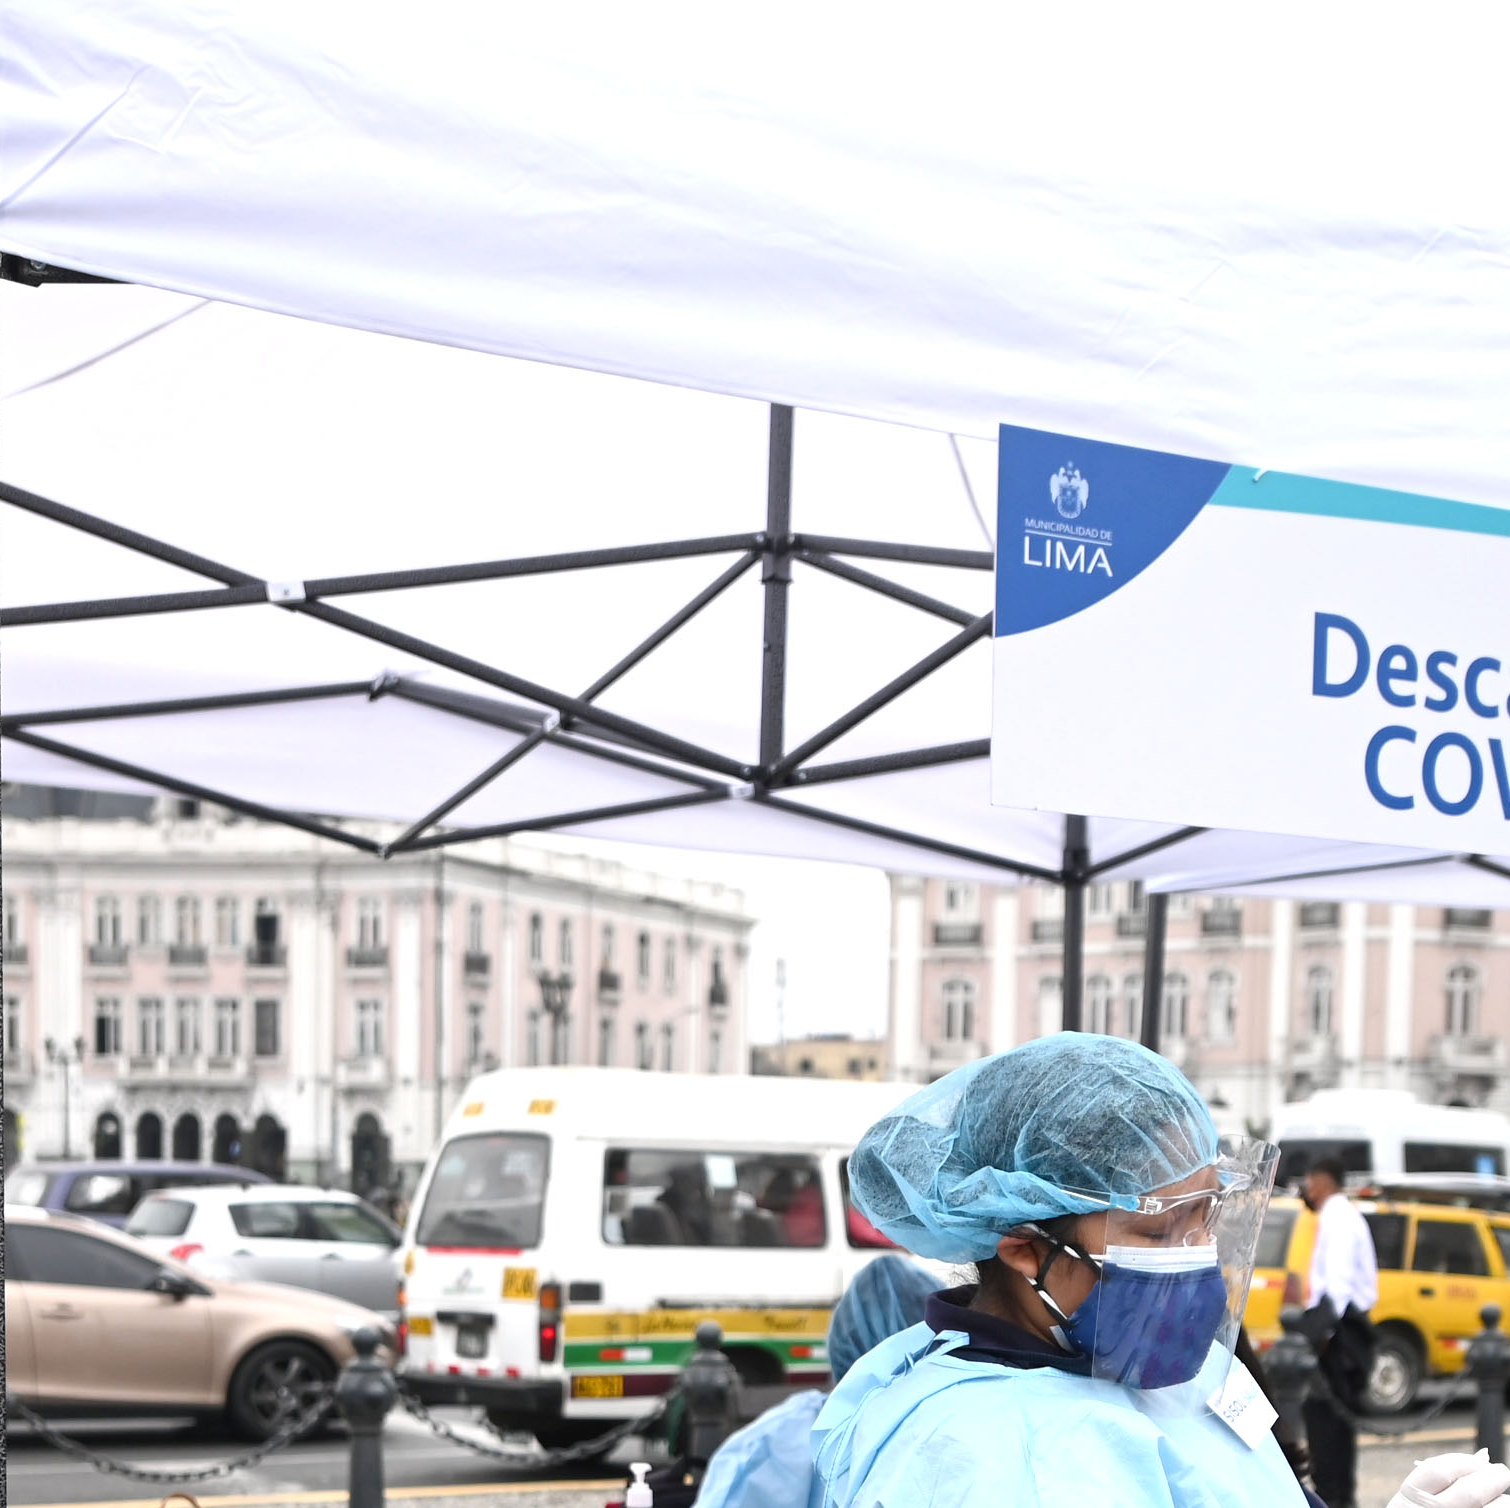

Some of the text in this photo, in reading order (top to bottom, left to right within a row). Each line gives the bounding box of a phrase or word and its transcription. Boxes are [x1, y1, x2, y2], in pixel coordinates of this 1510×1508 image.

[1025, 518, 1113, 541] MUNICIPALIDAD DE
[1024, 535, 1113, 577] LIMA
